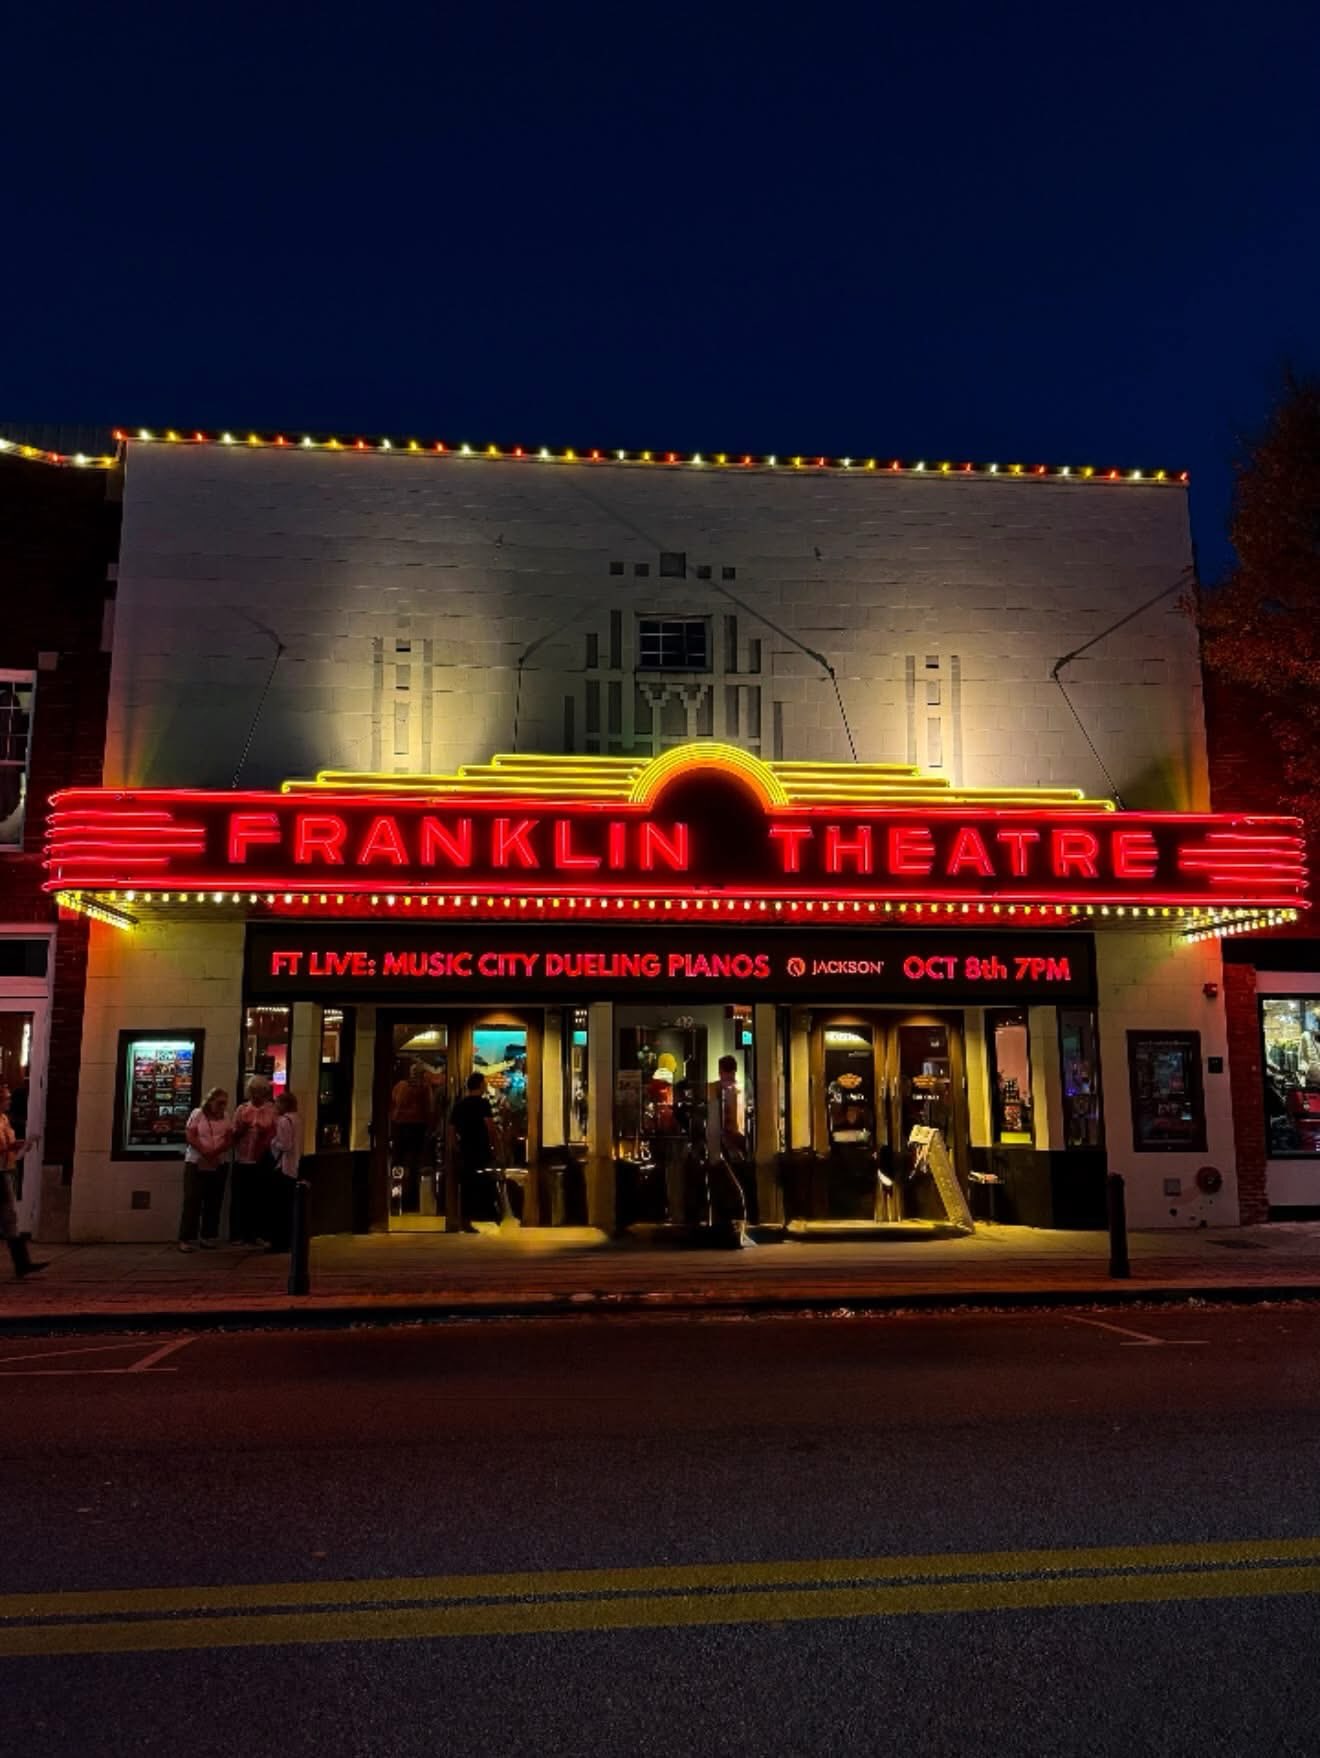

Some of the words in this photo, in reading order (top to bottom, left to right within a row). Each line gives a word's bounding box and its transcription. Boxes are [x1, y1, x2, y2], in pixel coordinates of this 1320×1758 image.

[228, 812, 689, 871] FRANKLIN
[769, 825, 1159, 878] THEATRE
[272, 952, 302, 976] FT
[310, 952, 376, 976] LIVE:
[383, 952, 473, 976] MUSIC
[478, 952, 540, 976] CITY
[546, 953, 661, 977] DUELING
[668, 953, 770, 978] PIANOS
[903, 956, 957, 979] OCT
[965, 956, 1007, 979] 8th
[1014, 957, 1071, 981] 7PM
